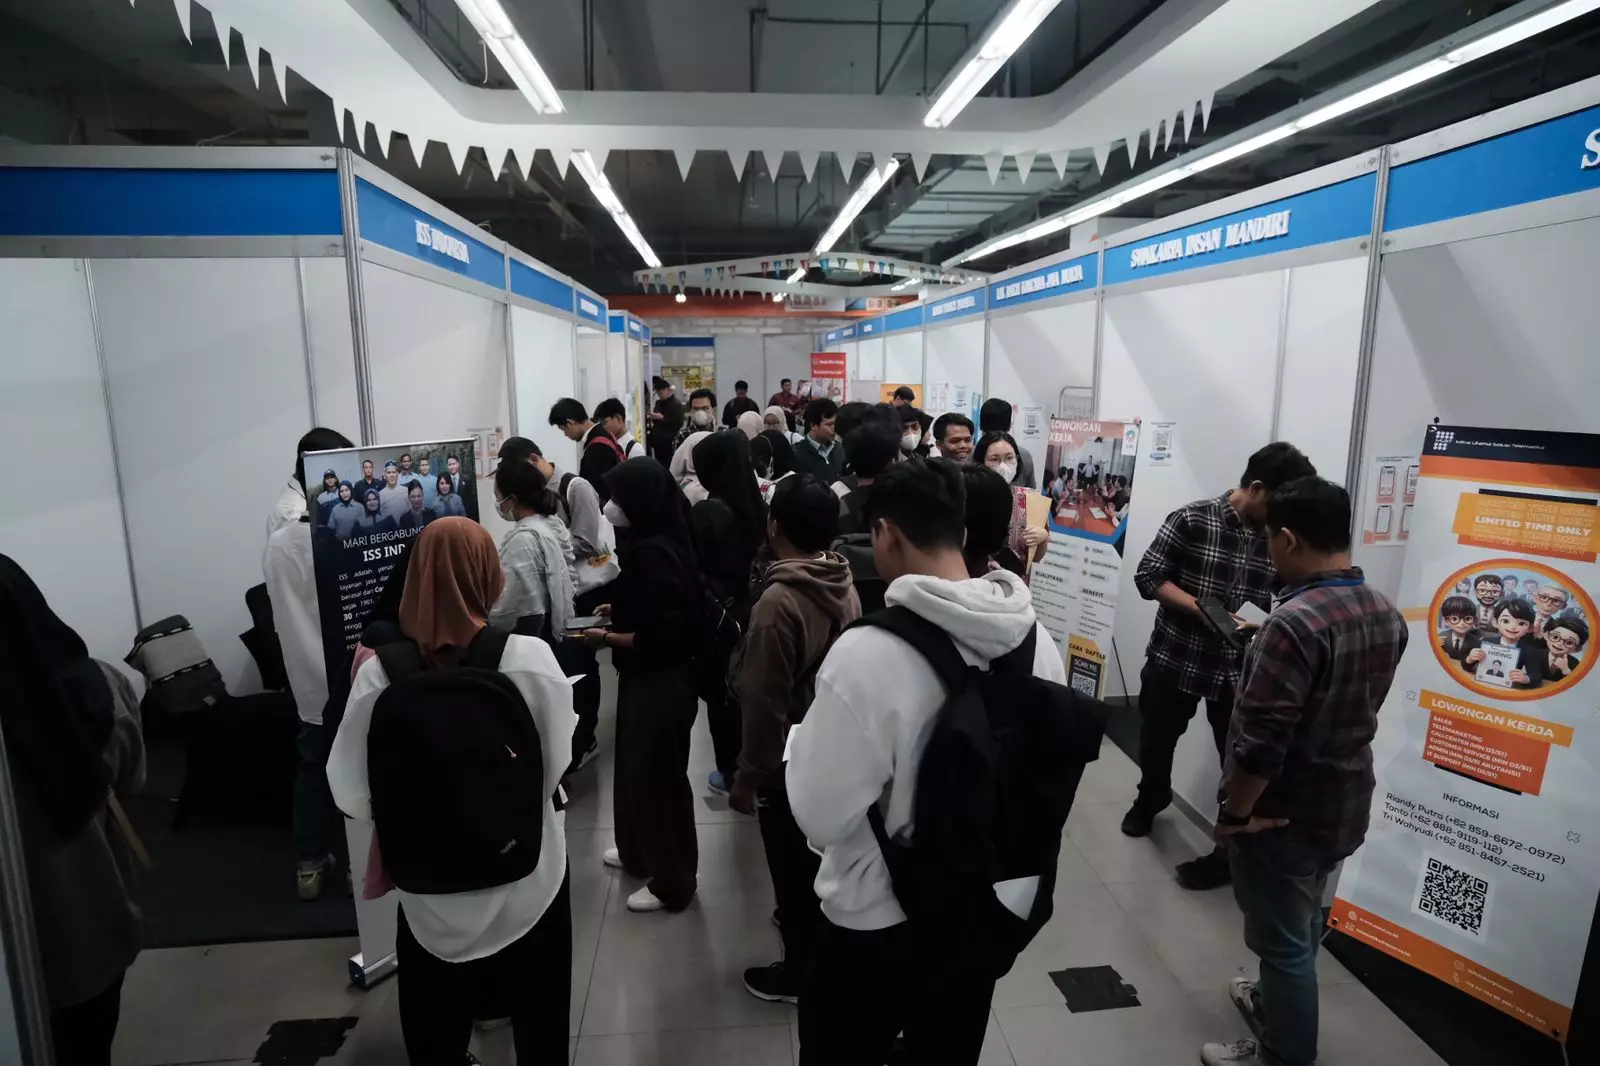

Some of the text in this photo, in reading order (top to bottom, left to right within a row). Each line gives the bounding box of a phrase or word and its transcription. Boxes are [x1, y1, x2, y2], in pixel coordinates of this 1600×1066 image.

[1185, 227, 1223, 256] INSAN
[1224, 210, 1291, 248] MANDIRI
[1050, 420, 1102, 433] LOWONGAN
[1049, 431, 1073, 443] KERJA
[1475, 515, 1521, 528] LIMITED
[1524, 521, 1553, 532] TIME
[1556, 526, 1592, 536] ONLY
[343, 536, 368, 549] MARI
[363, 548, 382, 562] ISS
[338, 573, 349, 581] ISS
[354, 568, 373, 578] adalah
[365, 578, 377, 587] jasa
[341, 590, 362, 601] berasal
[1082, 588, 1104, 598] BENEFIT
[343, 612, 353, 621] 30
[1069, 642, 1106, 660] CARA DAFTAR
[1488, 650, 1512, 660] HIRING
[1073, 658, 1088, 668] SCAN
[1431, 698, 1555, 738] LOWONGAN KERJA
[1433, 715, 1453, 726] SALES
[1430, 730, 1470, 746] CALLCENTER
[1469, 741, 1485, 751] (MIN
[1432, 722, 1484, 743] TELEMARKETING
[1428, 744, 1449, 756] ADMIN
[1481, 760, 1521, 777] AKUTANSI)
[1429, 737, 1463, 752] CUSTOMER
[1463, 746, 1491, 762] SERVICE
[1491, 755, 1508, 766] (MIN
[1432, 753, 1461, 769] SUPPORT
[1461, 762, 1477, 772] (MIN
[1442, 792, 1500, 820] INFORMASI
[1384, 802, 1503, 855] Tanto (+62 888-9119-112)
[1386, 792, 1566, 865] Riandy Putra (+62 859-6672-0972)
[1382, 811, 1545, 882] Tri Wahyudi (+62 851-8457-2521)
